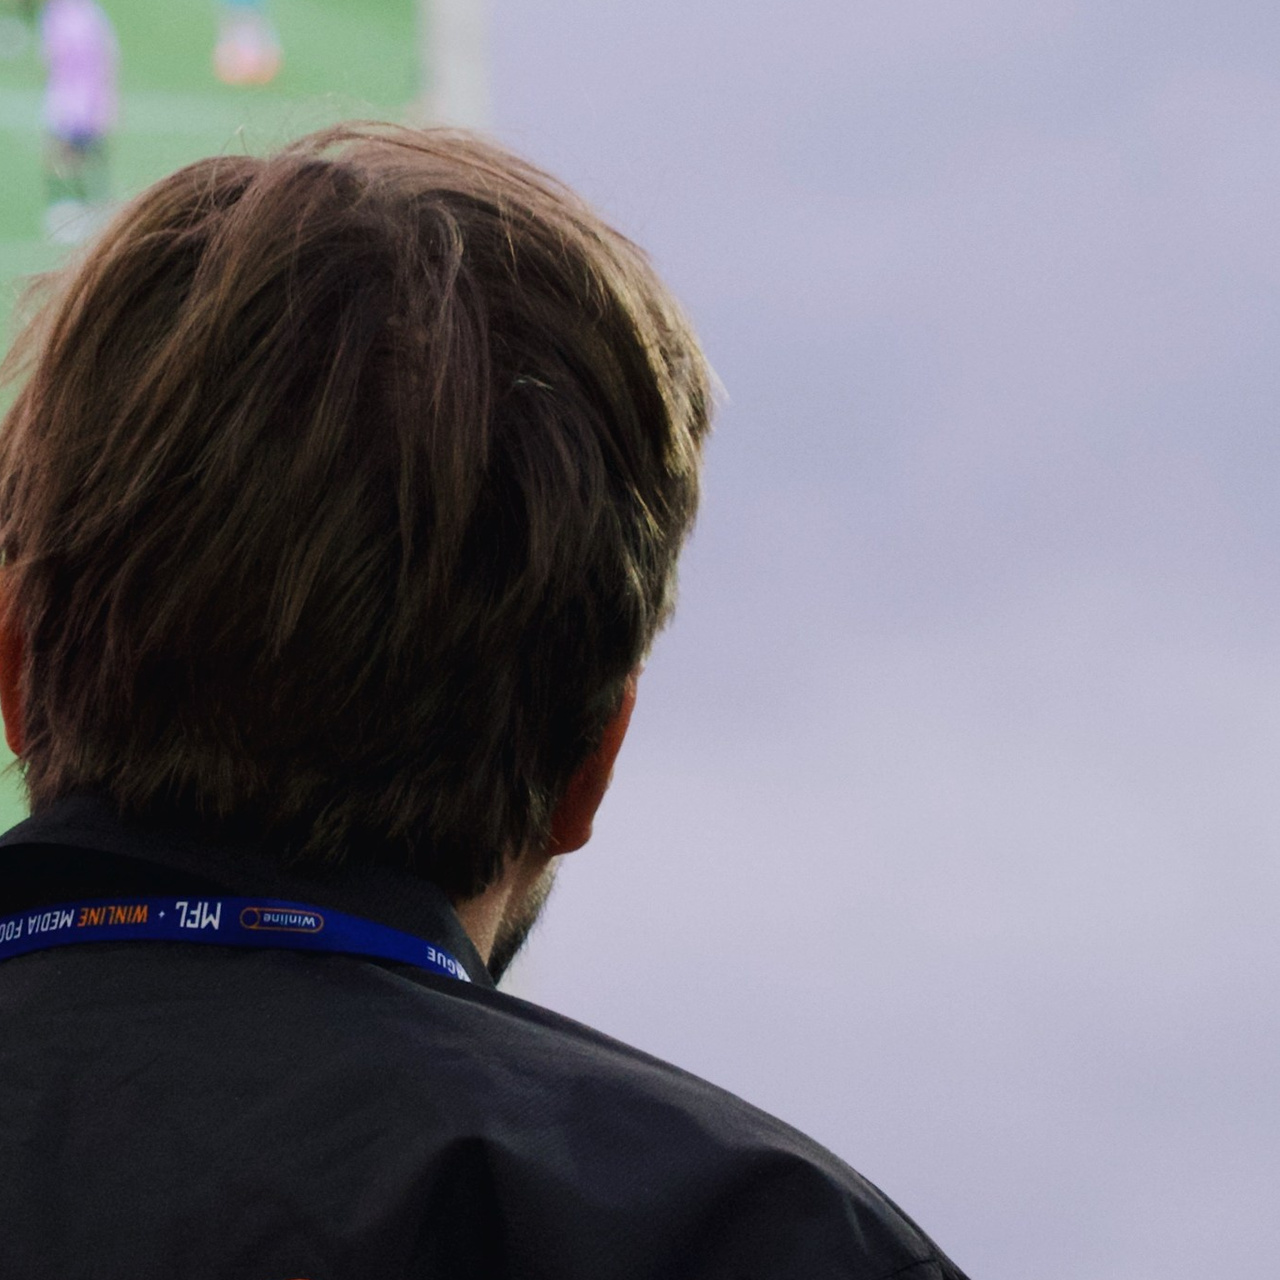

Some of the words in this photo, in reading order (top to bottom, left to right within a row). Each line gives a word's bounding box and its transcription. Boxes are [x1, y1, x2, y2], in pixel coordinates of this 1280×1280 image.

[27, 909, 74, 935] MEDIA
[77, 905, 148, 927] WINLINE
[175, 901, 221, 930] MFL
[263, 913, 316, 928] Winline
